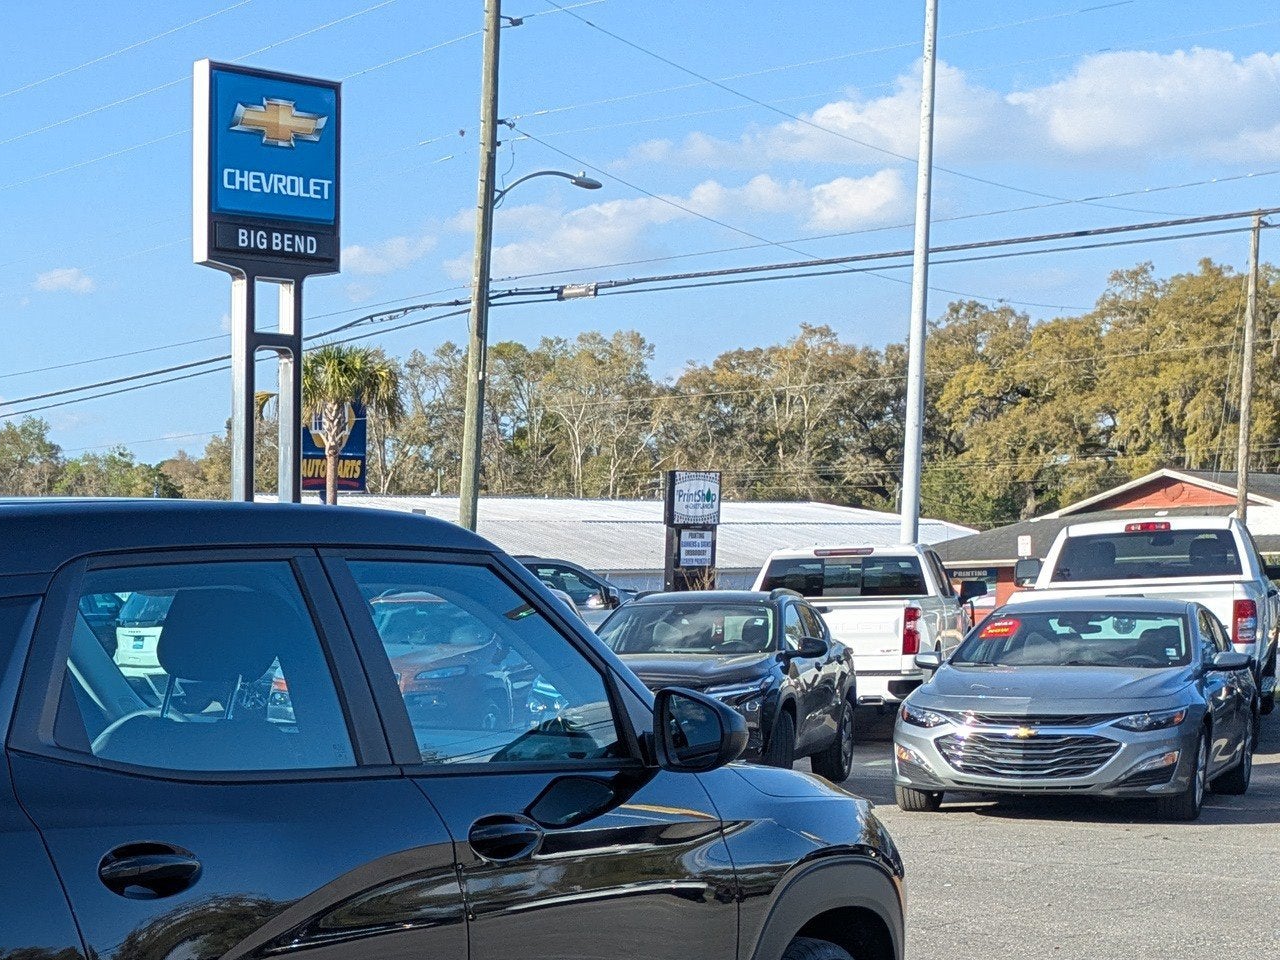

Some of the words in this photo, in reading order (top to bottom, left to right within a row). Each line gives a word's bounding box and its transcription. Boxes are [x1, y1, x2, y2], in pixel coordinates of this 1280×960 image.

[223, 168, 332, 200] CHEVROLET
[238, 228, 268, 250] BIG
[272, 232, 317, 254] BEND
[302, 459, 327, 478] AUTO
[331, 460, 362, 478] ARTS
